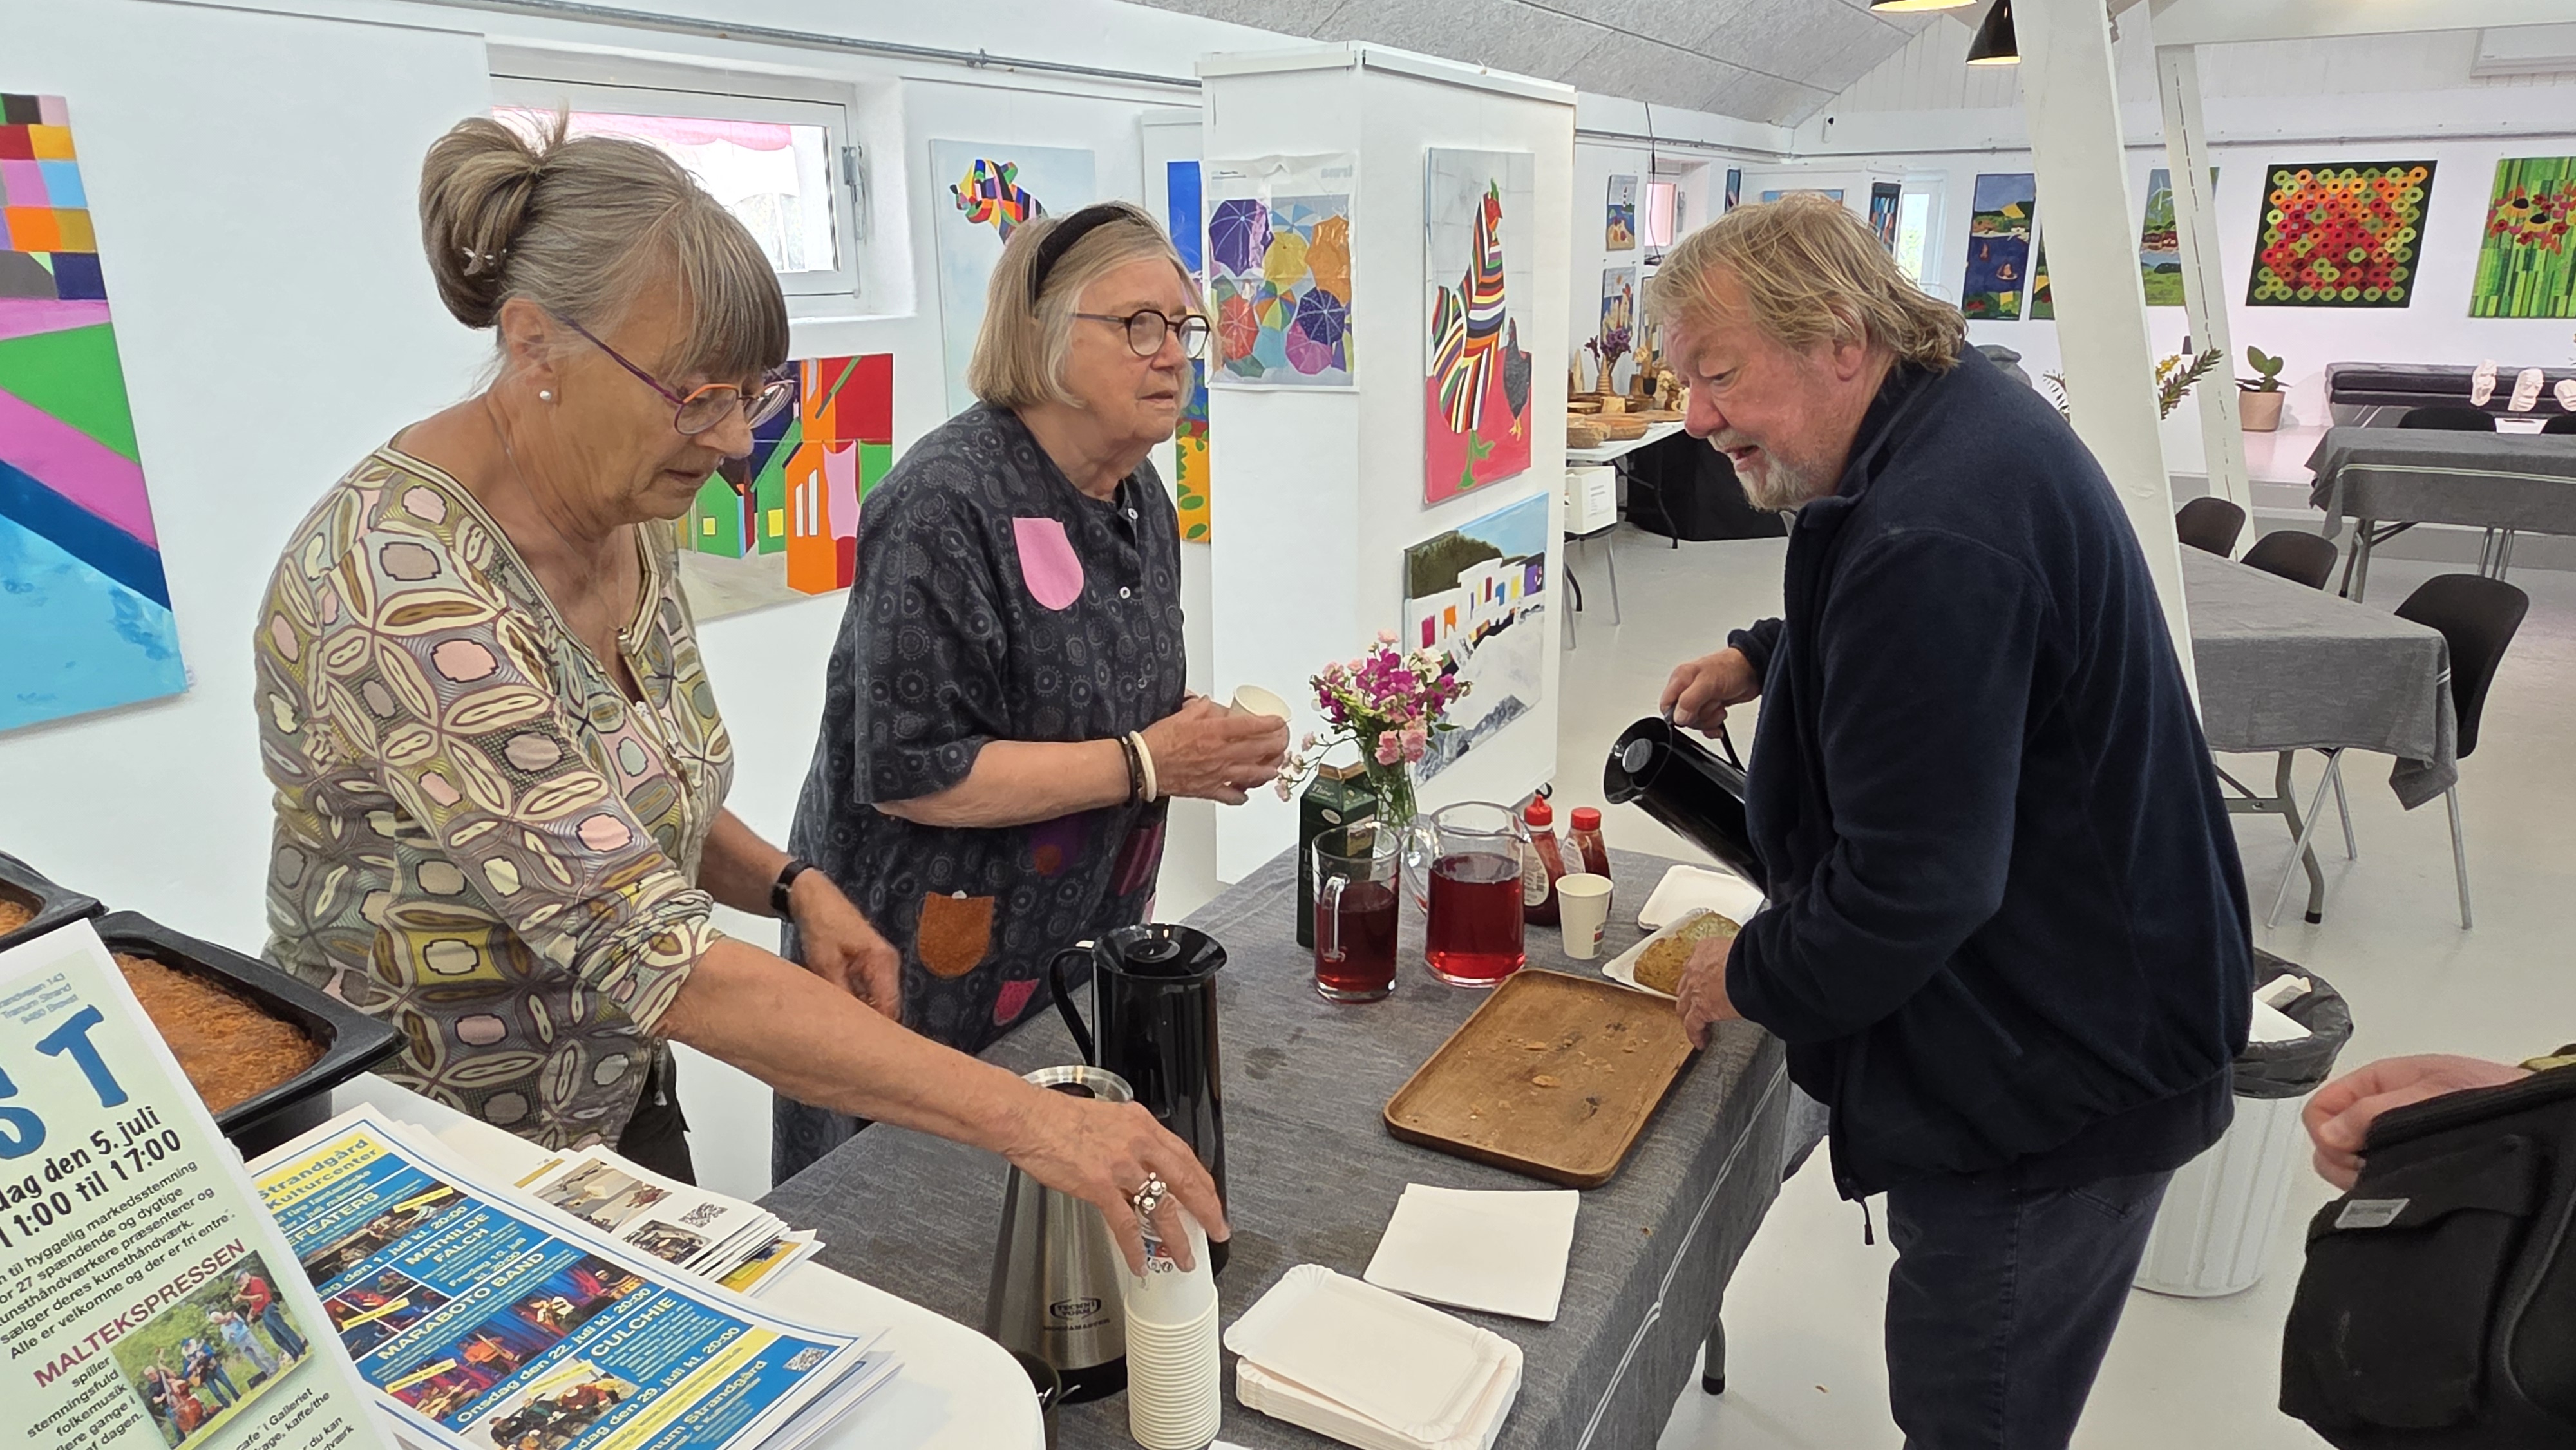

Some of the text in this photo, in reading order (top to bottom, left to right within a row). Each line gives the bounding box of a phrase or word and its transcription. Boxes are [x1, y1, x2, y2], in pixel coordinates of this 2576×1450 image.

[44, 1148, 92, 1183] den
[90, 1129, 119, 1155] 5.
[117, 1106, 161, 1146] juli
[75, 1170, 109, 1202] til
[110, 1129, 181, 1181] 17:00
[258, 1138, 370, 1200] Strandgård
[265, 1148, 378, 1210] Kulturcenter
[8, 1161, 198, 1277] til hyggelig markedsstemning
[16, 1276, 34, 1294] 27
[37, 1230, 117, 1281] spændende
[118, 1216, 138, 1231] og
[137, 1187, 184, 1222] dygtige
[120, 1198, 196, 1253] præsenterer
[197, 1188, 216, 1203] og
[343, 1263, 374, 1283] den
[388, 1239, 413, 1256] juli
[413, 1229, 432, 1242] kl.
[430, 1205, 468, 1230] 20:00
[404, 1212, 490, 1265] MATHILDE
[433, 1227, 490, 1263] FALCH
[1, 1219, 196, 1344] sælger deres kunsthåndværk.
[10, 1337, 39, 1360] Alle
[41, 1324, 56, 1340] er
[58, 1281, 124, 1327] velkomne
[126, 1268, 144, 1285] og
[144, 1255, 167, 1273] der
[167, 1244, 182, 1256] er
[181, 1233, 198, 1248] fri
[33, 1238, 246, 1388] MALTEKSPRESSEN
[377, 1286, 491, 1361] MARABOTO
[490, 1252, 545, 1287] BAND
[456, 1379, 521, 1424] Onsdag
[520, 1358, 550, 1381] den
[547, 1342, 574, 1361] 22.
[571, 1324, 596, 1345] juli
[594, 1314, 616, 1328] kl.
[613, 1287, 652, 1315] 20:00
[590, 1296, 677, 1357] CULCHIE
[27, 1369, 120, 1438] stemningsfuld
[71, 1356, 111, 1388] spiller
[609, 1402, 639, 1426] den
[659, 1366, 686, 1387] juli
[683, 1354, 705, 1369] kl.
[701, 1326, 741, 1355] 20:00
[683, 1359, 768, 1426] Strandgård
[56, 1383, 129, 1436] folkemusik
[88, 1401, 129, 1435] gange
[100, 1413, 144, 1445] dagen.
[269, 1388, 314, 1426] Galleriet
[285, 1391, 331, 1431] kaffe/the
[309, 1416, 343, 1447] du kan
